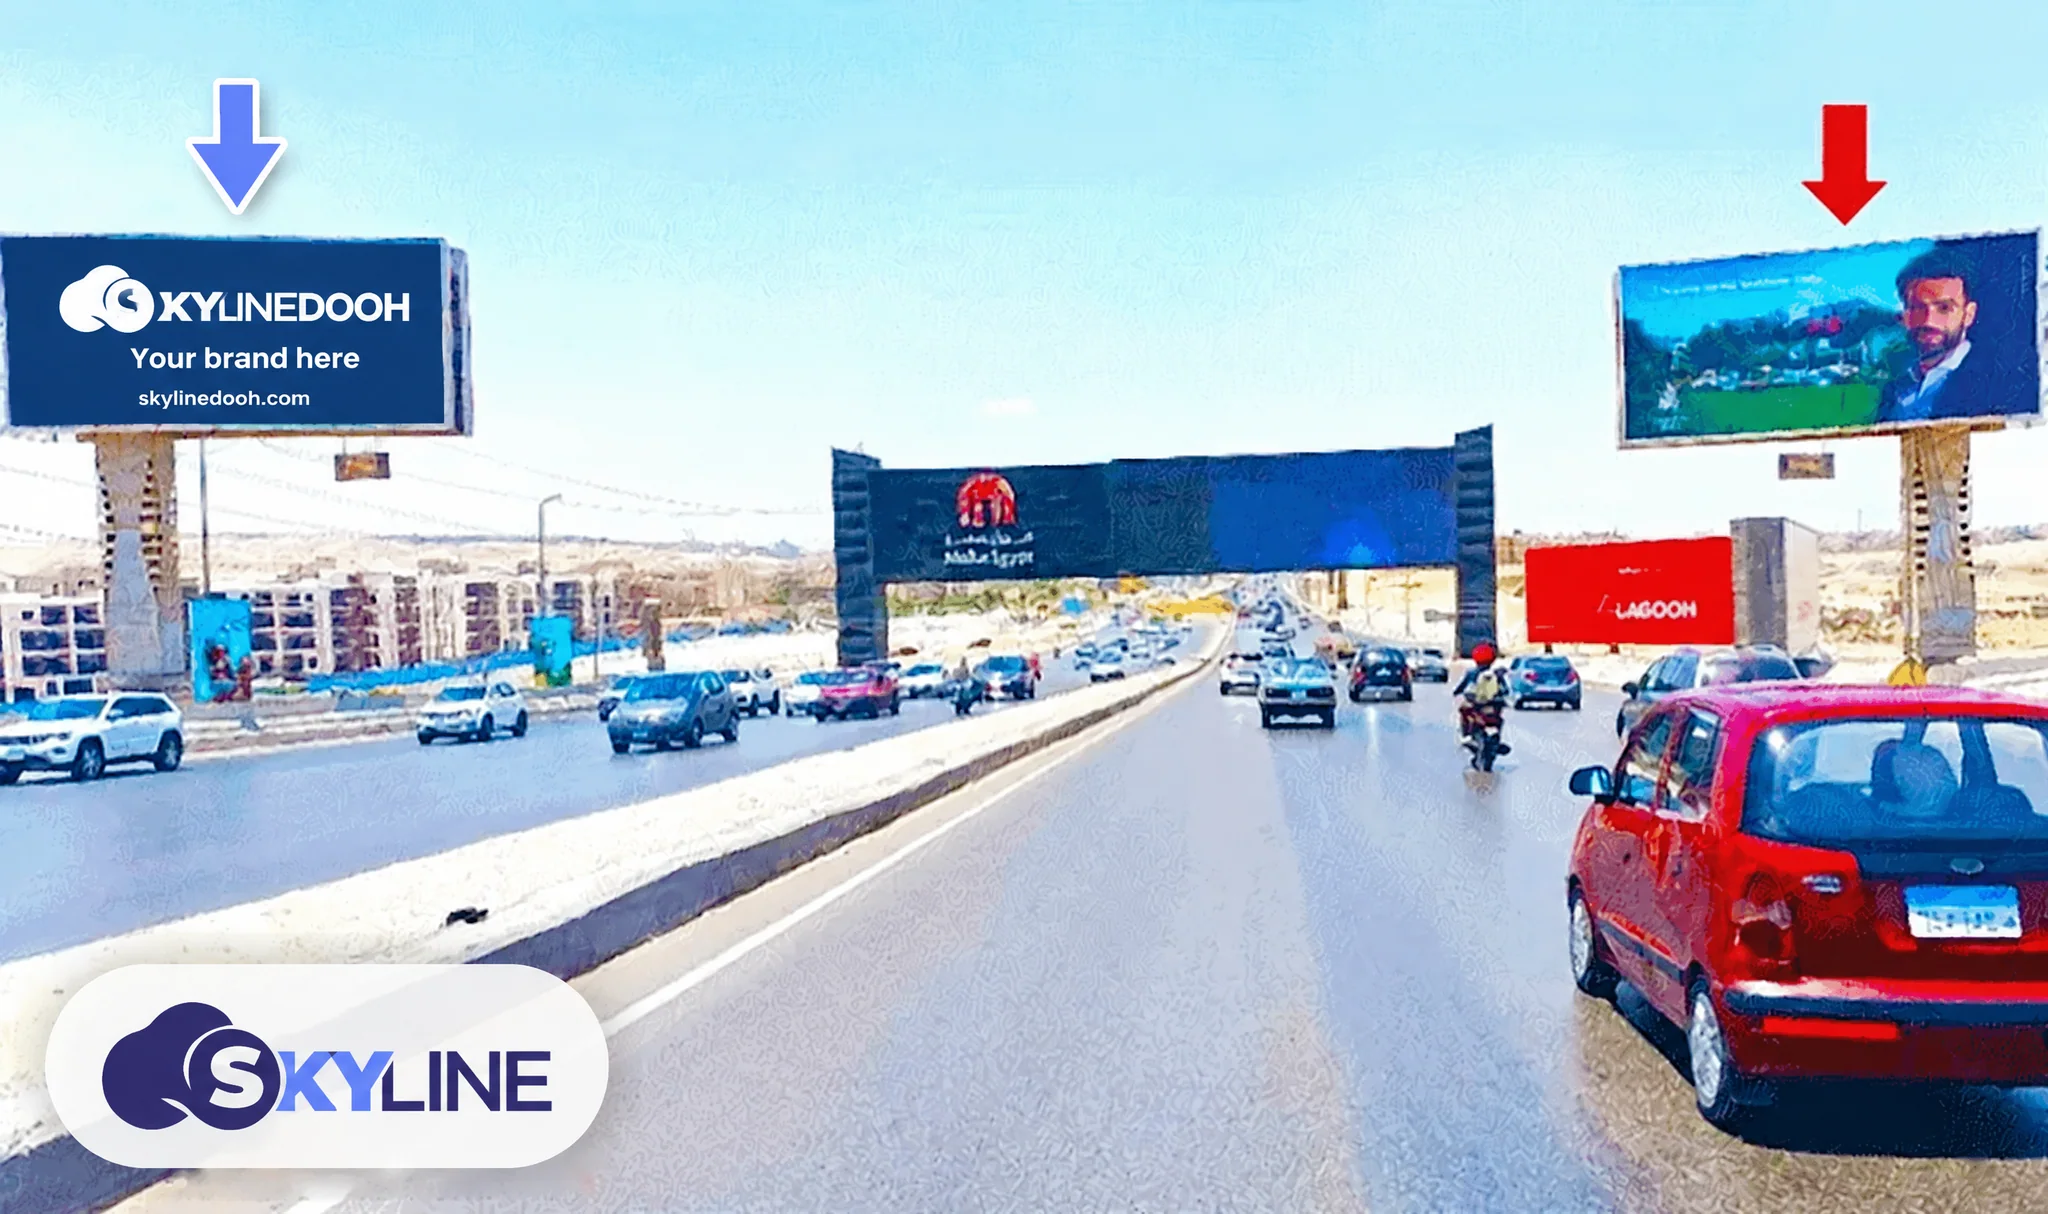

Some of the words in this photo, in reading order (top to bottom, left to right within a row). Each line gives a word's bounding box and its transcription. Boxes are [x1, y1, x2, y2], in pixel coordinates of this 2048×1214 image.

[130, 347, 197, 369] Your
[204, 346, 288, 369] brand
[296, 346, 360, 369] here
[138, 389, 310, 410] skylinedooh.com
